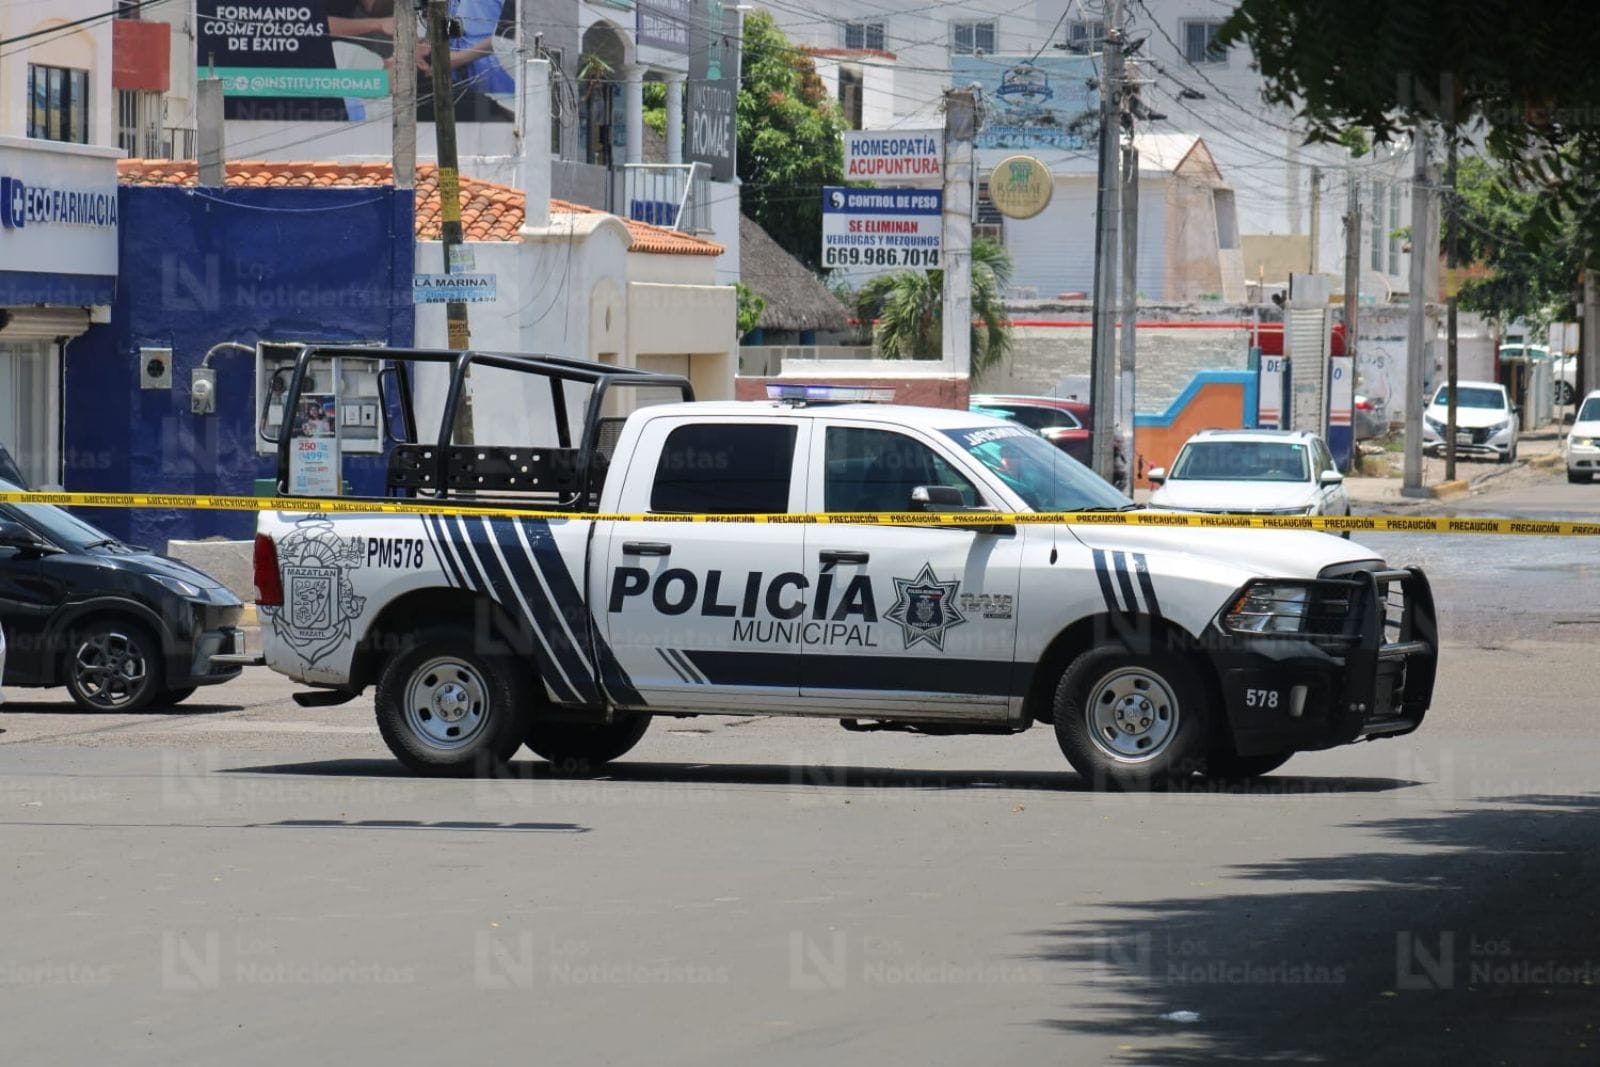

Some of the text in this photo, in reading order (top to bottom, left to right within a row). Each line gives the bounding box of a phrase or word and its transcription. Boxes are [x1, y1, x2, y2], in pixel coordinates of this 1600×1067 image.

[216, 6, 311, 21] FORMANDO
[204, 20, 323, 37] COSMETÓLOGAS
[228, 38, 248, 51] DE
[251, 76, 380, 91] @INSTITUTOROMAE
[693, 84, 731, 113] INSTITUTO
[692, 110, 730, 158] ROMAE
[851, 135, 936, 156] HOMEOPATÍA
[848, 158, 939, 175] ACUPUNTURA
[848, 195, 937, 209] CONTROL DE PESO
[848, 220, 918, 233] SE ELIMINAN
[826, 235, 939, 247] VERRUGAS Y MEZQUINOS
[826, 247, 939, 266] 669.986.7014
[414, 279, 487, 287] LA MARINA
[829, 515, 879, 524] PRECAUCIÓN
[891, 514, 941, 523] PRECAUCIÓN
[1138, 515, 1188, 525] PRECAUCIÓN
[1200, 516, 1251, 526] PRECAUCIÓN
[1262, 518, 1313, 527] PRECAUCIÓN
[1325, 519, 1375, 528] PRECAUCIÓN
[1387, 520, 1437, 530] PRECAUCIÓN
[1449, 521, 1499, 531] PRECAUCIÓN
[1510, 523, 1560, 533] PRECAUCIÓN
[1572, 526, 1600, 536] PRECA
[367, 537, 424, 568] PM578
[287, 568, 337, 577] MAZATLAN
[607, 562, 878, 622] POLICÍA
[732, 619, 878, 648] MUNICIPAL
[1246, 688, 1279, 708] 578
